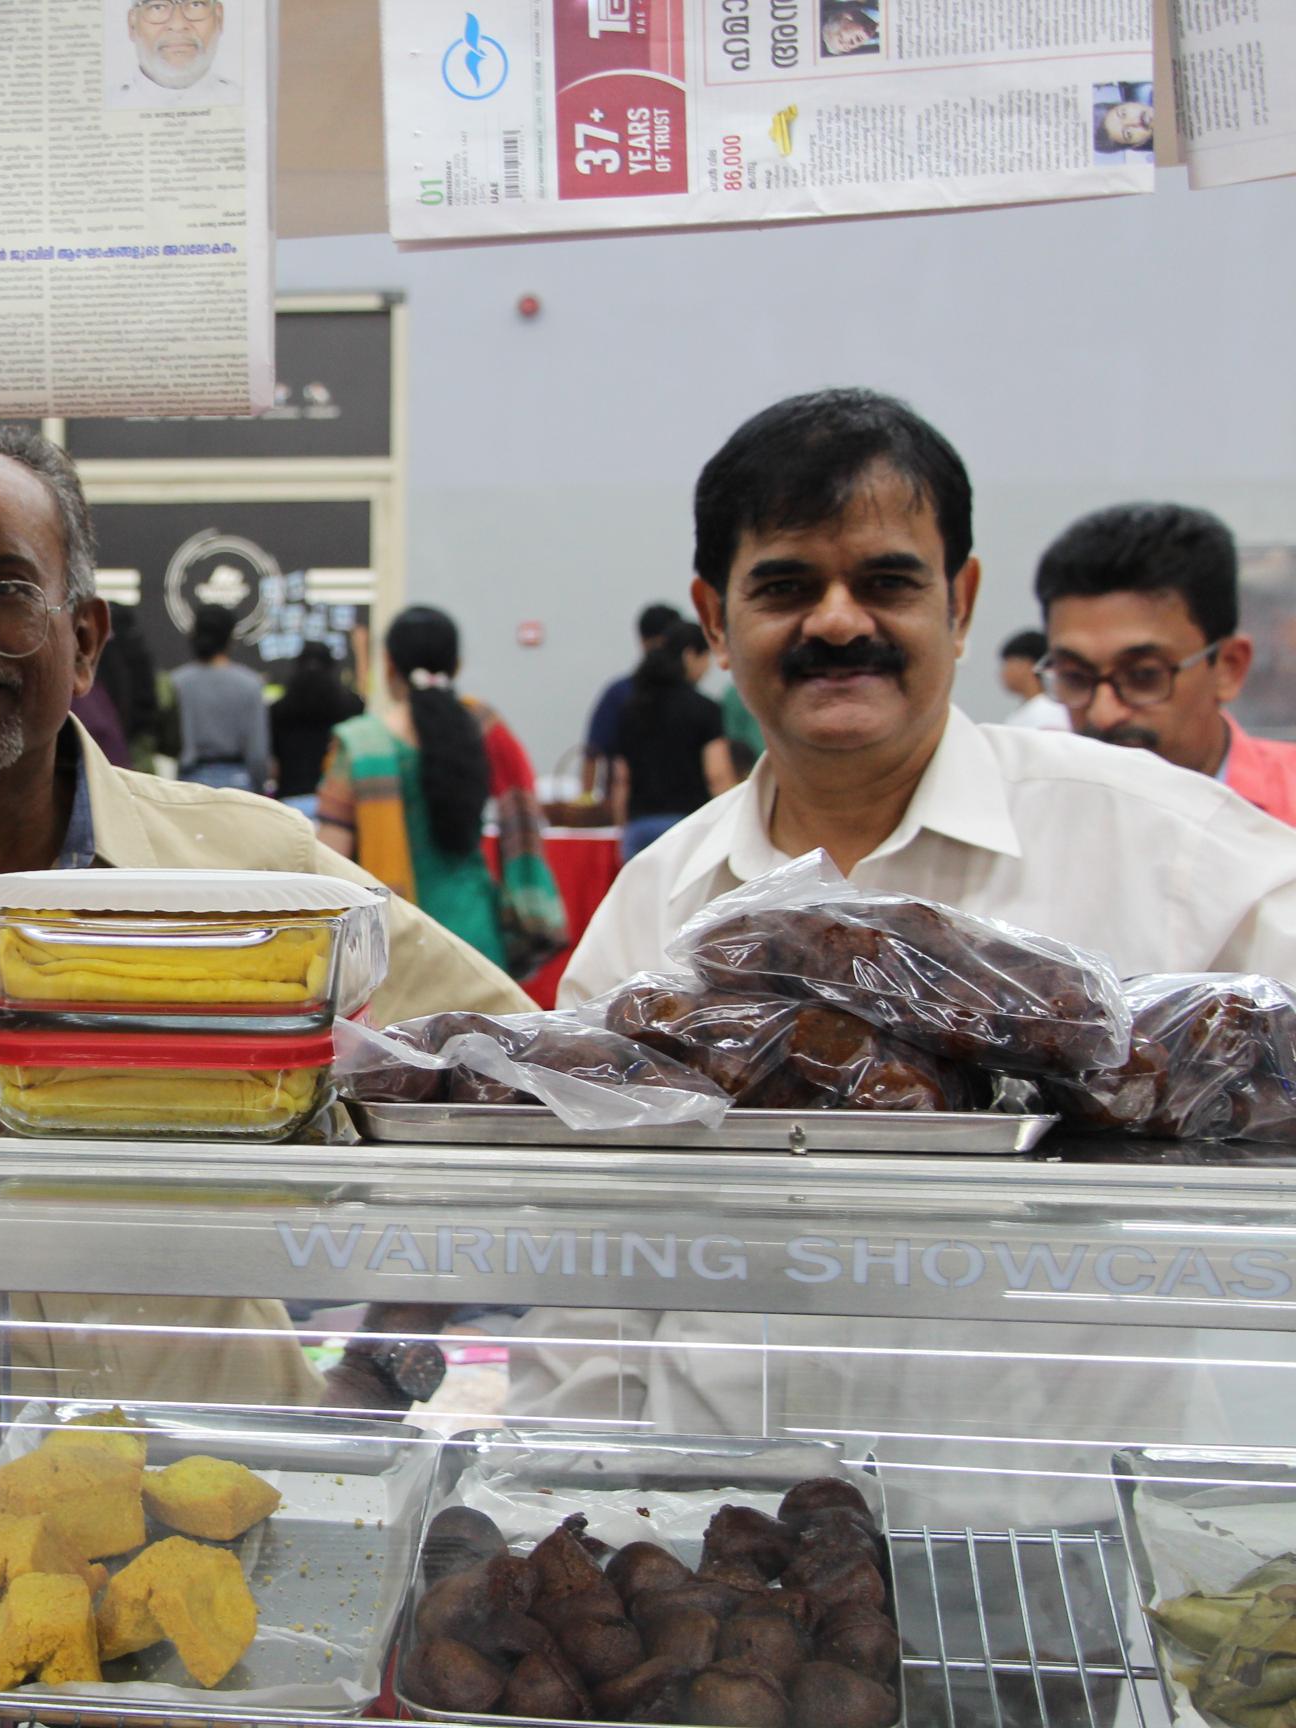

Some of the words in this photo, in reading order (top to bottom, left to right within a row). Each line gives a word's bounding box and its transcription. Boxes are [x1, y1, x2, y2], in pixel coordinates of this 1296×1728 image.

[627, 107, 652, 176] YEARS
[652, 107, 671, 152] TRUST
[654, 155, 672, 173] OF
[722, 134, 743, 192] 86,000
[419, 178, 444, 206] 01
[490, 181, 500, 205] UAE
[274, 1219, 748, 1281] WARMING
[784, 1235, 1294, 1301] SHOWCAS
